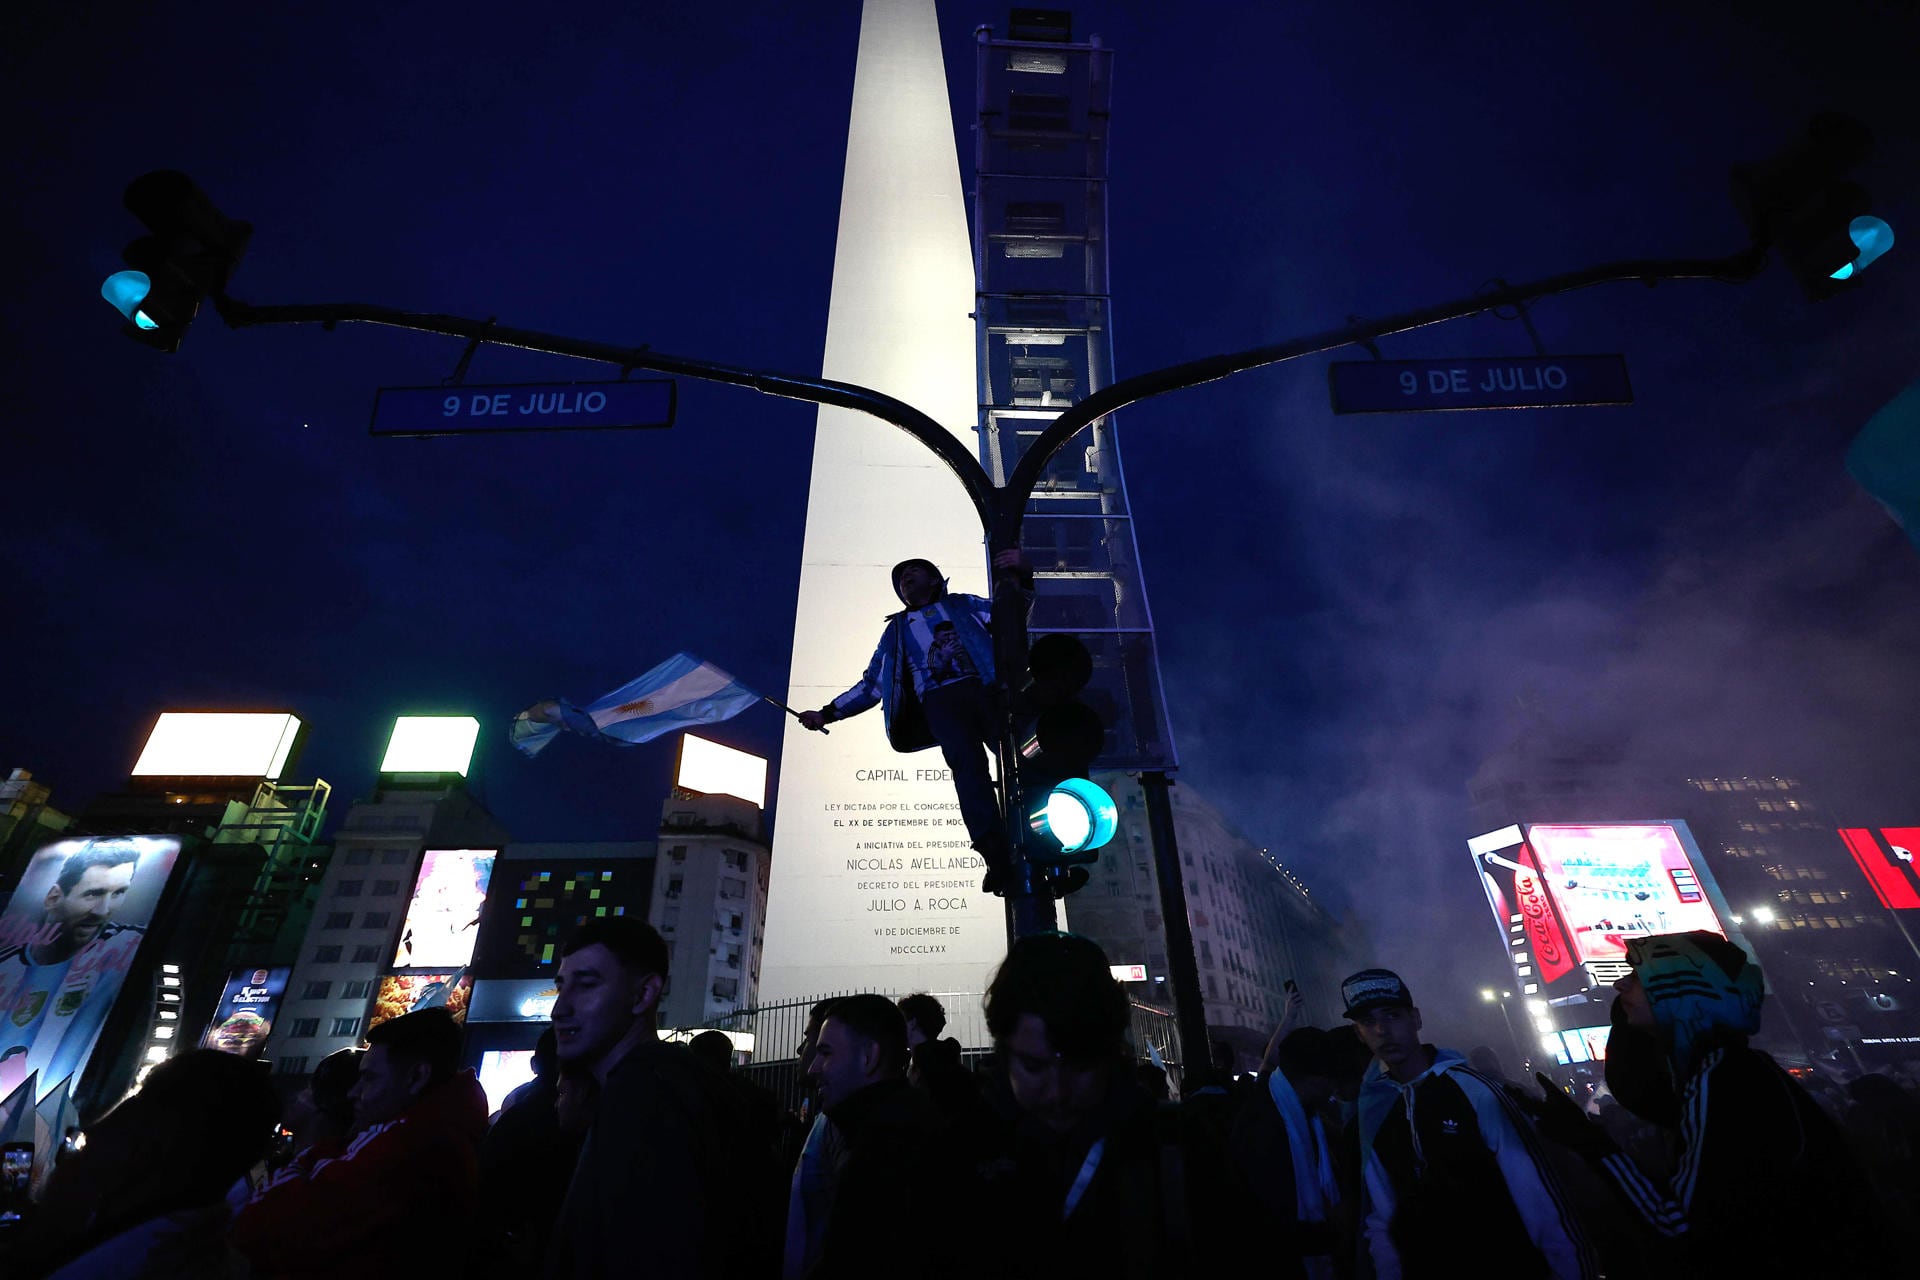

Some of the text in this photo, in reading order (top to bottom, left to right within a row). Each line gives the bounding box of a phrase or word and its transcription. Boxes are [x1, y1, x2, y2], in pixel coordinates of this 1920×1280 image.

[1400, 365, 1568, 395] 9 DE JULIO
[443, 391, 606, 417] 9 DE JULIO
[856, 769, 953, 781] CAPITAL FEDE
[844, 803, 876, 811] DICTADA
[880, 803, 897, 811] POR
[900, 803, 911, 811] EL
[834, 819, 844, 827] EL
[848, 819, 859, 827] XX
[863, 819, 873, 827] DE
[877, 818, 928, 827] SEPTIEMBRE
[932, 818, 943, 826] DE
[856, 840, 973, 850] A INICIATIVA DEL PRESIDENT
[847, 856, 985, 872] NICOLAS AVELLANEDA
[857, 880, 975, 890] DECRETO DEL PRESIDENTE
[867, 898, 906, 912] JULIO
[929, 897, 968, 911] ROCA
[874, 926, 960, 936] VI DE DICIEMBRE DE
[890, 945, 946, 954] MDCCCLXXX
